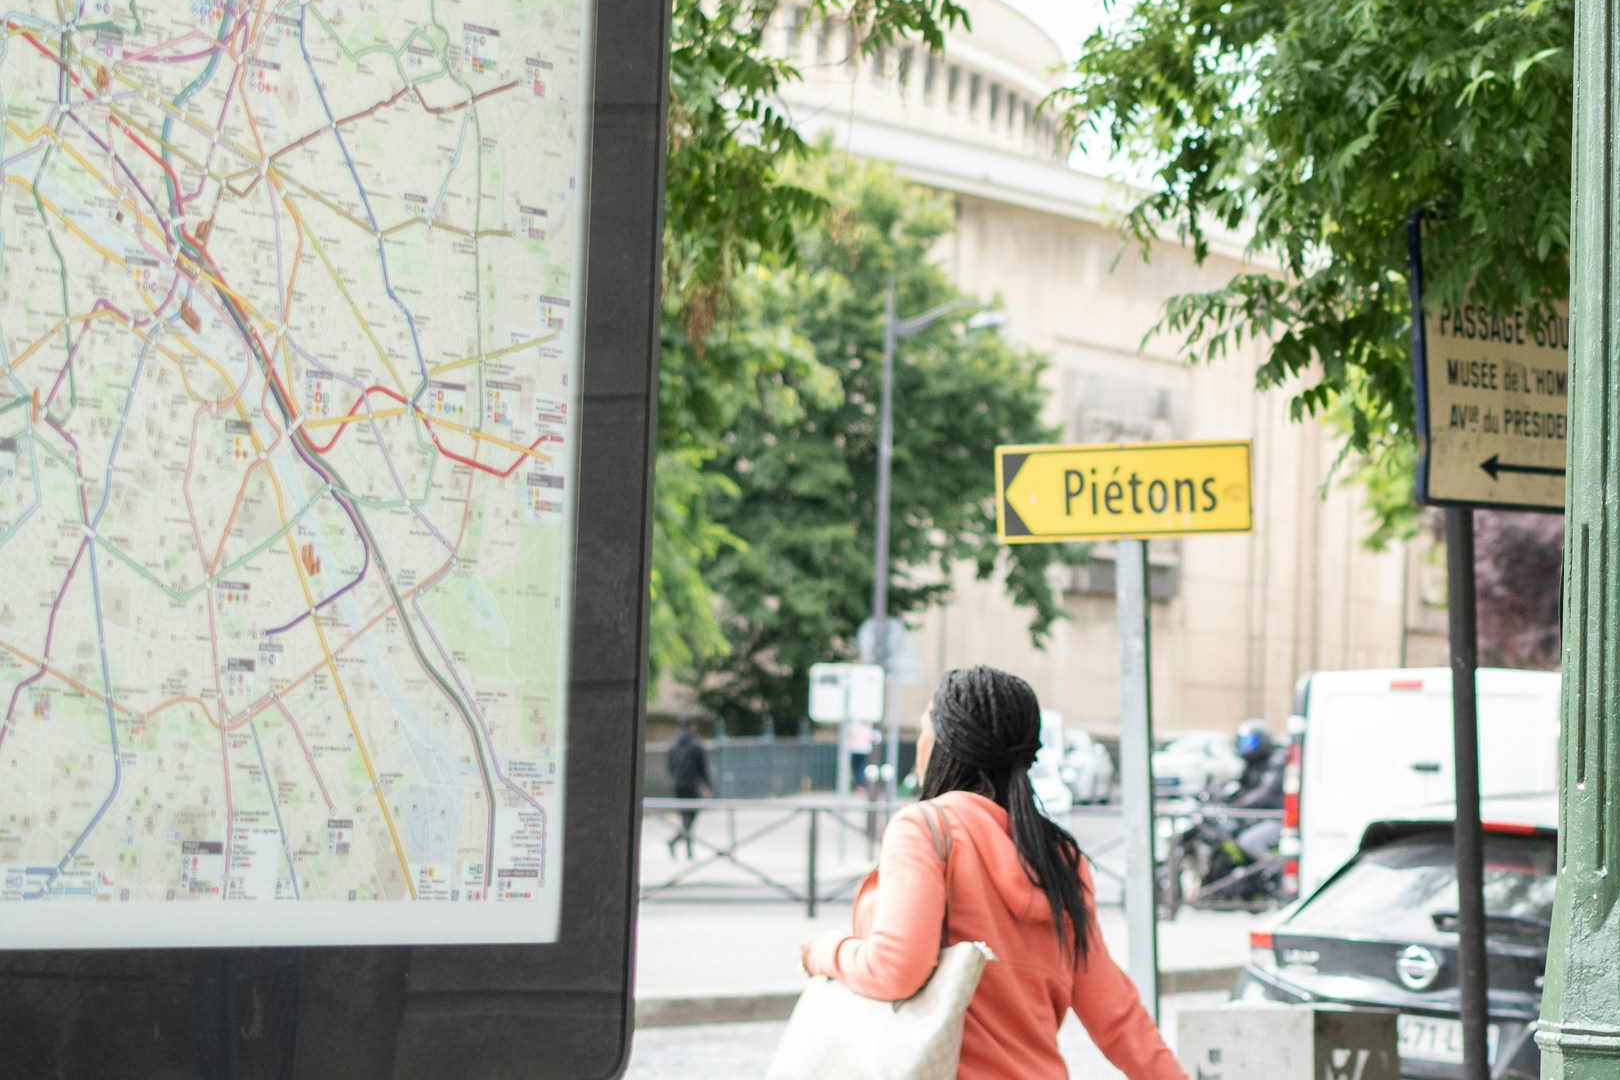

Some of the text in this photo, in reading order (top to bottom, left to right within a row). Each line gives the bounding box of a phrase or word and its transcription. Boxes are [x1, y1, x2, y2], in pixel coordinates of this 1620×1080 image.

[1440, 304, 1525, 345] PASSAGE
[1503, 363, 1519, 393] de
[1484, 408, 1500, 434] du
[1504, 407, 1567, 440] PRÉSIDE
[1064, 466, 1218, 516] Piétons
